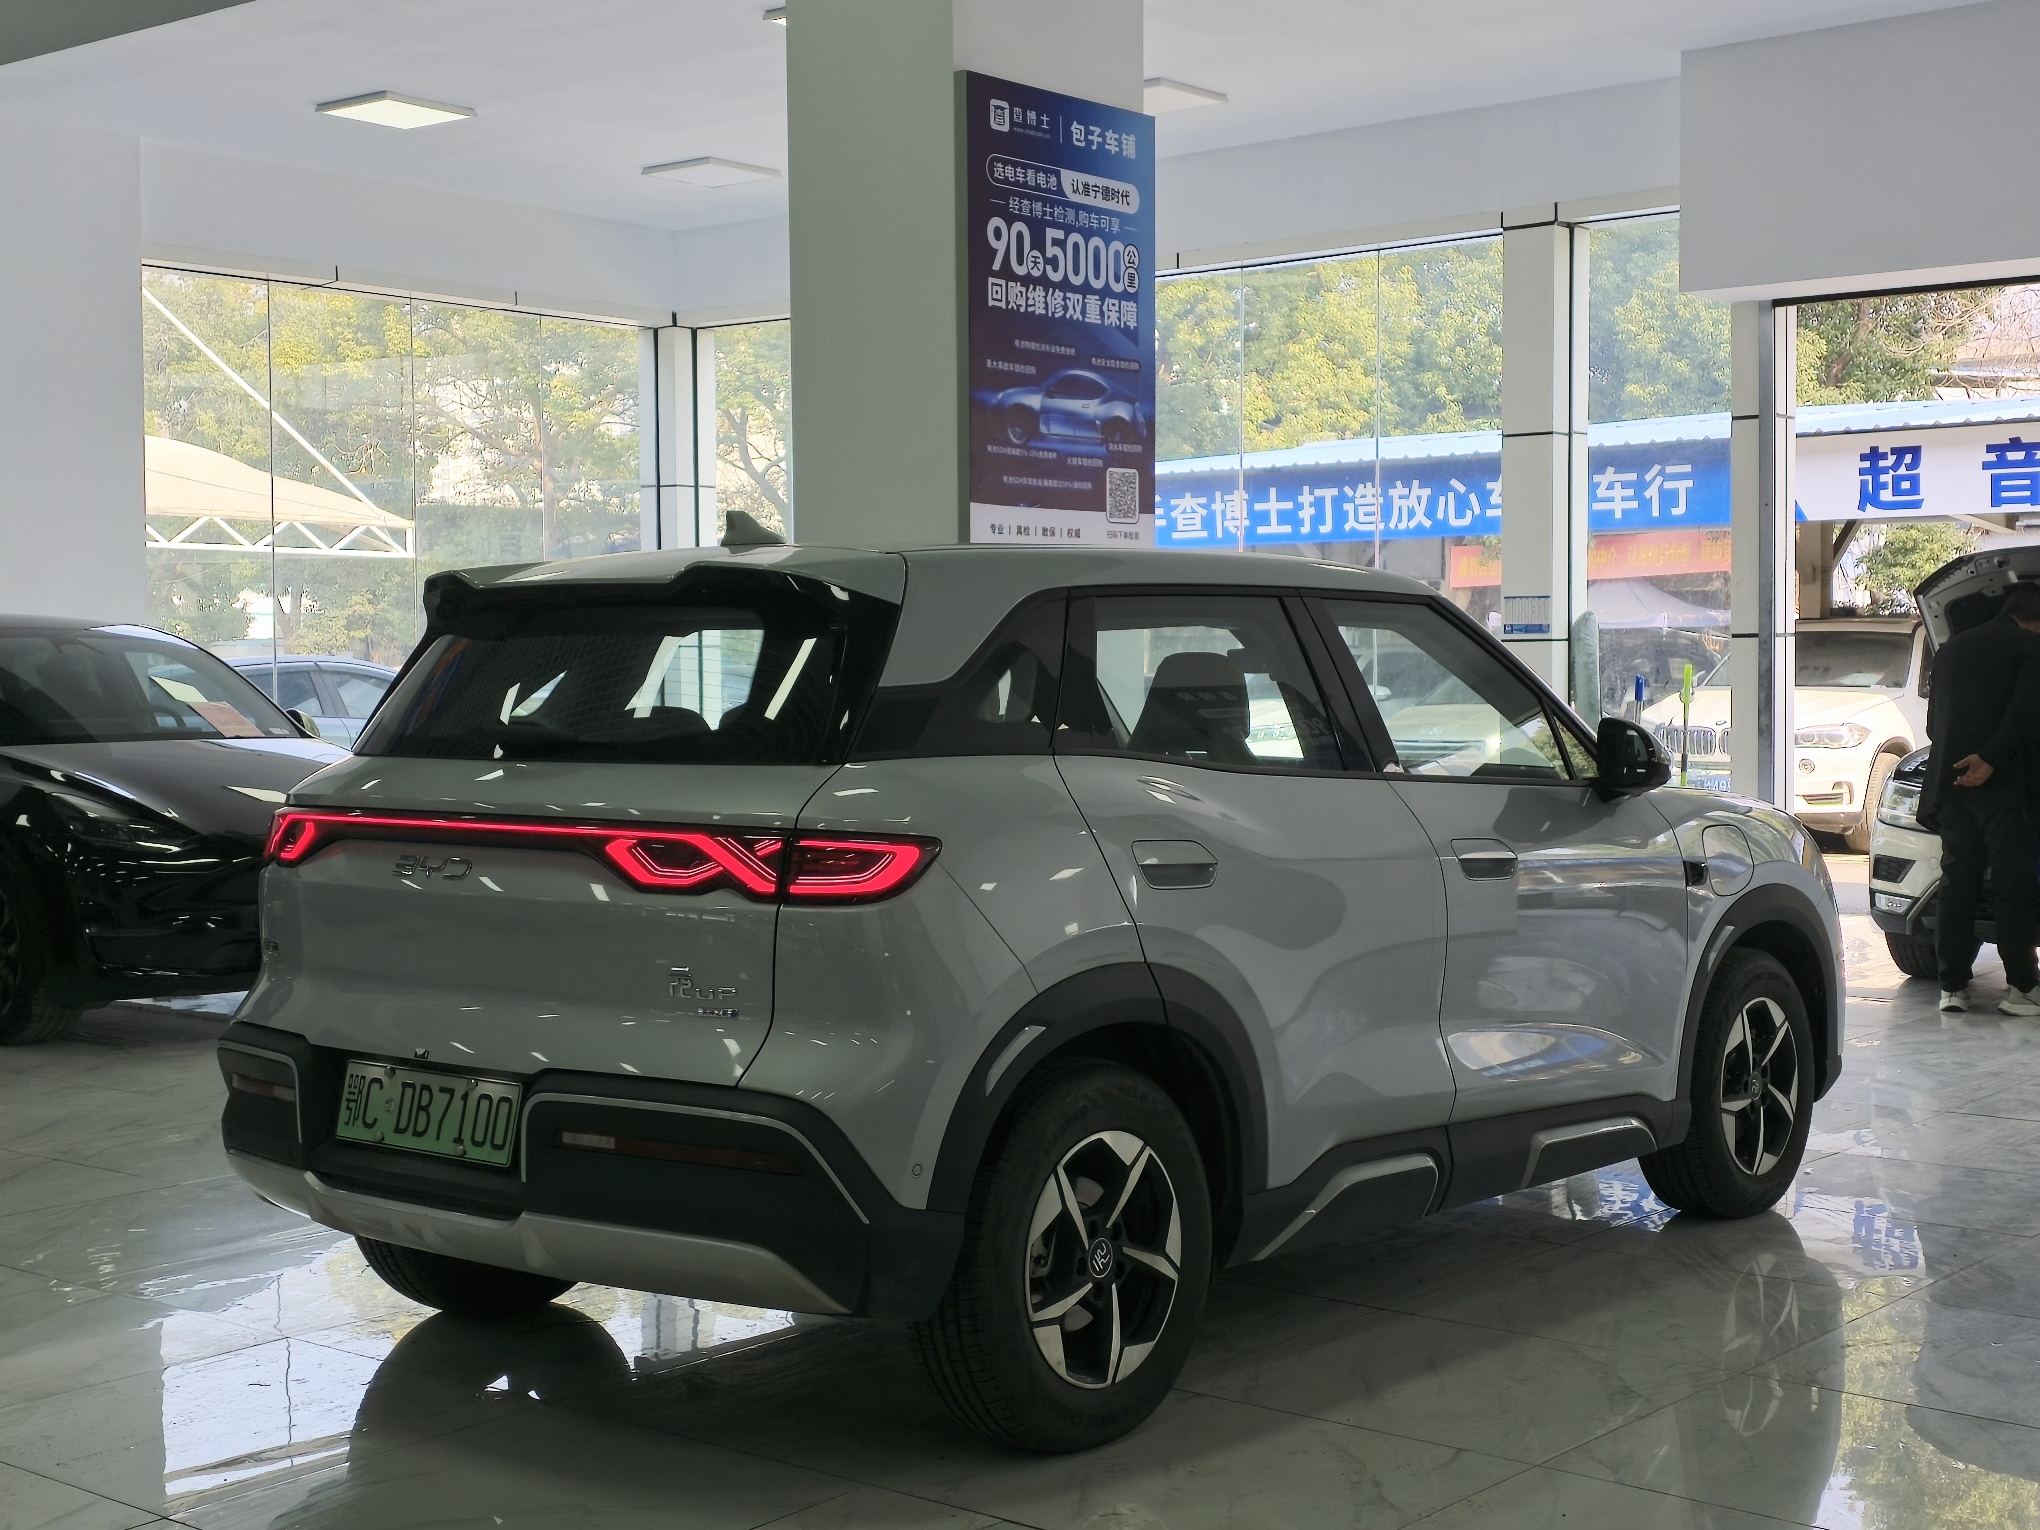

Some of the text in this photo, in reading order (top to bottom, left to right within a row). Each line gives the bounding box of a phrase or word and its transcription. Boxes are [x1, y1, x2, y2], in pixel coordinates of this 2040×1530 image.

[1012, 106, 1051, 129] 查博士
[1070, 120, 1136, 159] 包子车铺
[993, 161, 1058, 190] 选电车看电池
[1071, 178, 1130, 206] 认准宁德时代
[987, 276, 1138, 330] 回购维修双重保障
[1592, 463, 1694, 519] 车行
[990, 523, 1004, 535] 专业
[1067, 528, 1081, 539] 权威
[391, 854, 473, 880] BYD
